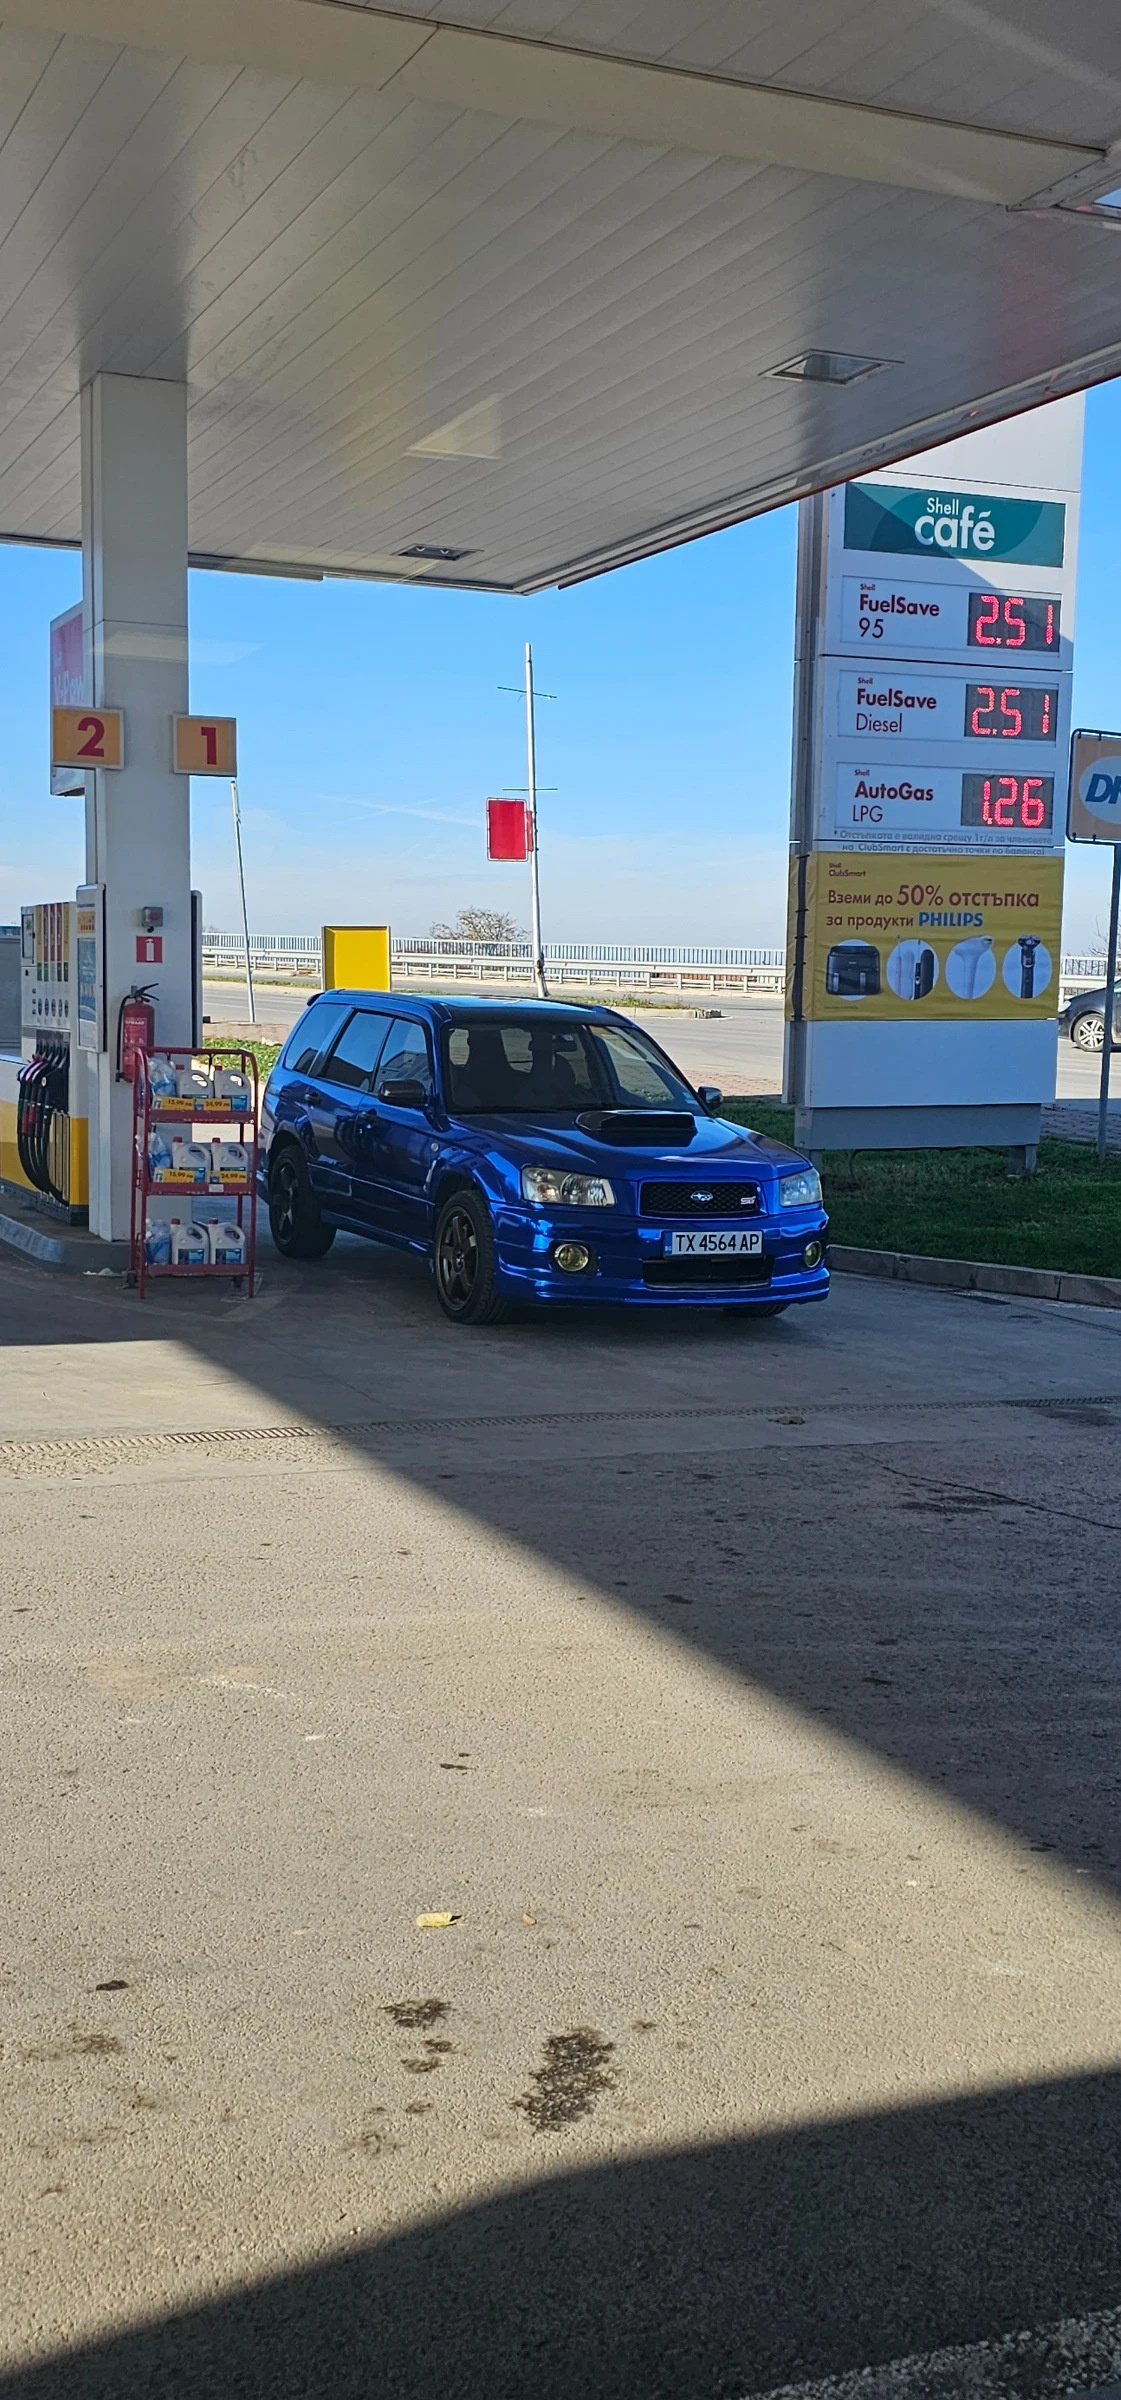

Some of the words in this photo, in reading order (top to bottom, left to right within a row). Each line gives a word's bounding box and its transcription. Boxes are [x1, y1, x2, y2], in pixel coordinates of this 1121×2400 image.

[926, 497, 960, 516] Shell
[914, 505, 996, 551] café
[860, 583, 876, 591] Shell
[858, 594, 940, 616] FuelSave
[858, 618, 885, 639] 95
[857, 677, 873, 685] Shell
[856, 688, 937, 710] FuelSave
[855, 712, 903, 733] Diesel
[76, 716, 105, 758] 2
[200, 726, 217, 766] 1
[854, 769, 870, 777] Shell
[854, 780, 934, 802] AutoGas
[852, 804, 883, 823] LPG
[858, 842, 904, 852] ClubSmart
[828, 869, 866, 877] ClubSmart
[828, 889, 871, 904] Вземи
[875, 894, 893, 906] до
[897, 884, 944, 907] 50%
[949, 891, 1039, 907] отстъпка
[826, 915, 843, 926] за
[847, 916, 914, 930] продукти
[918, 911, 984, 928] PHILIPS
[675, 1234, 696, 1252] TX
[699, 1234, 736, 1252] 4564
[739, 1233, 759, 1251] AP
